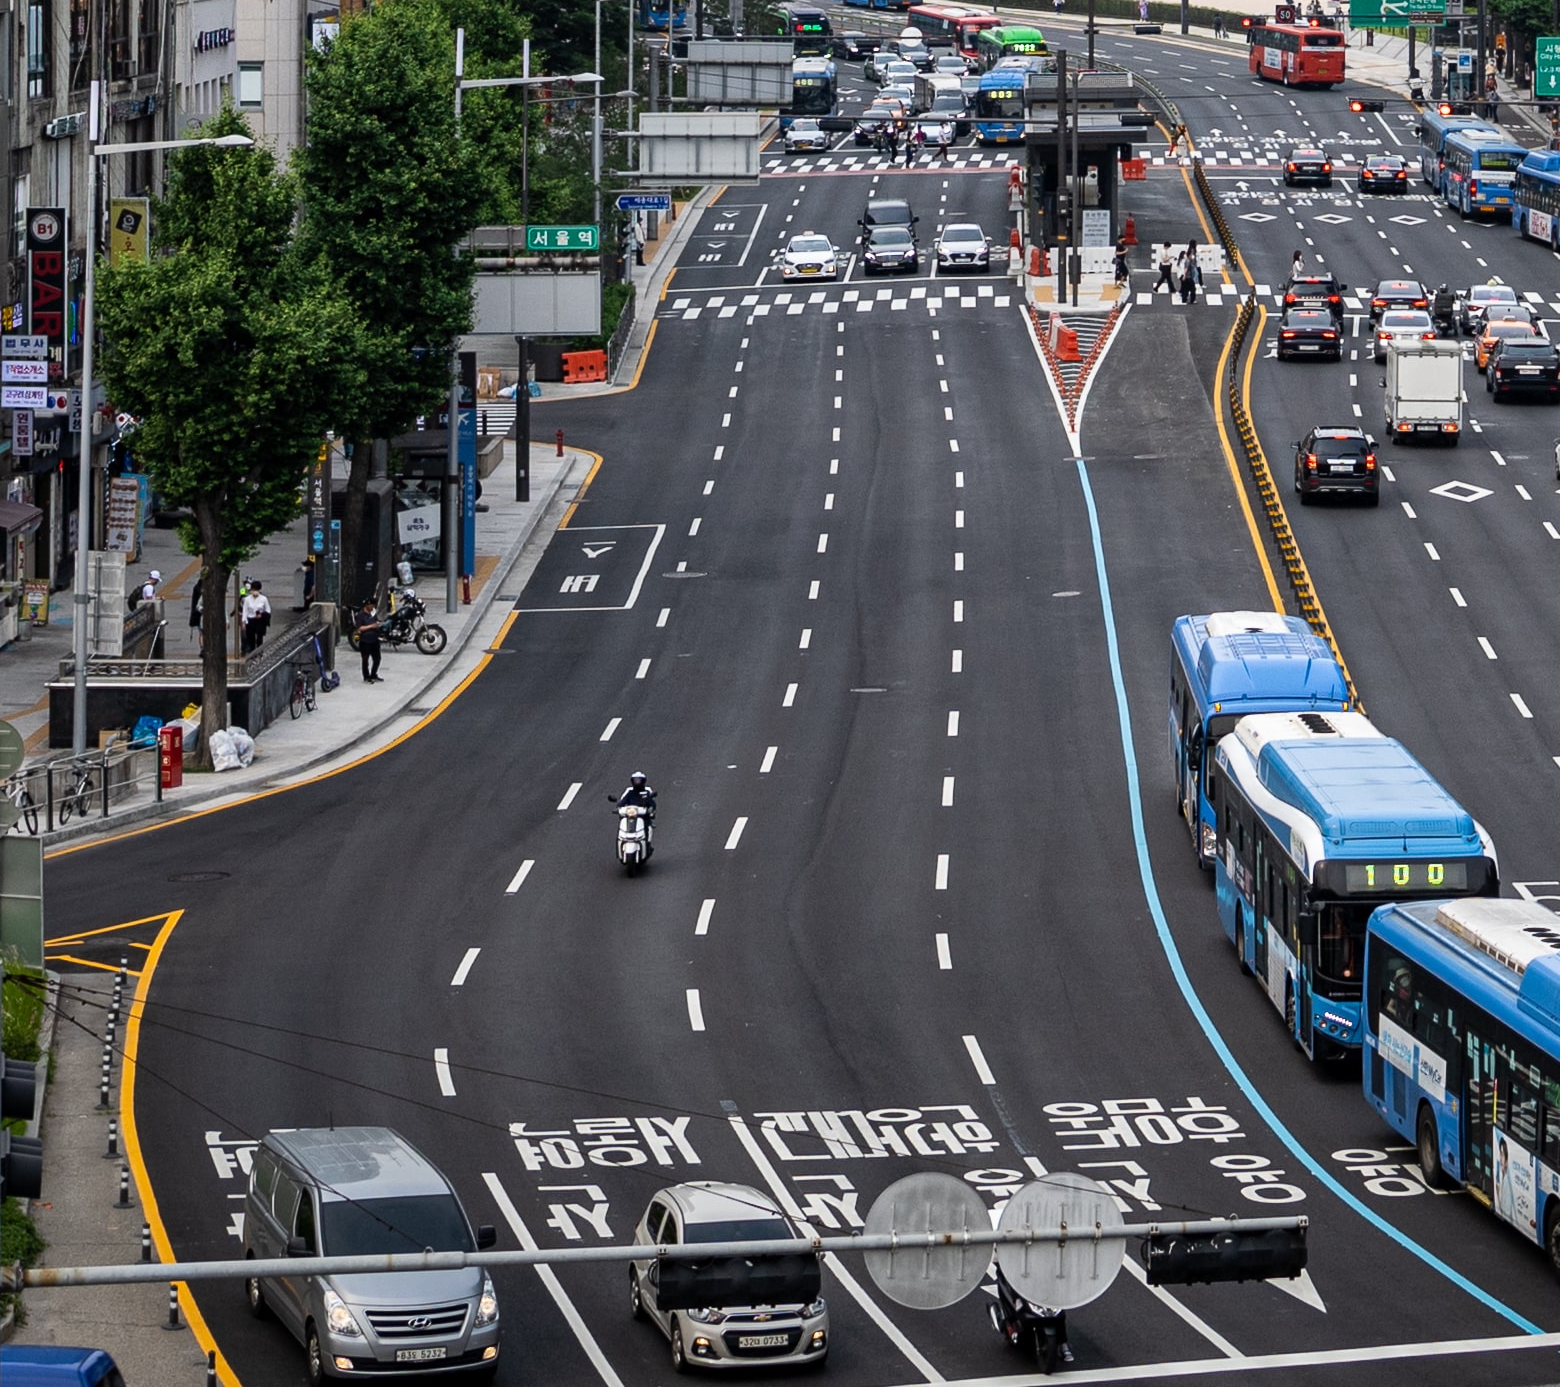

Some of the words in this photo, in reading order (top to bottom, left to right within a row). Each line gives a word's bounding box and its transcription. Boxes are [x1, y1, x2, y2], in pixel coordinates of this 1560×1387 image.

[36, 222, 54, 235] B1
[532, 230, 592, 247] 서울역
[33, 251, 62, 337] BAR
[5, 337, 44, 348] 법무사
[1365, 863, 1445, 886] 100
[762, 1337, 785, 1346] 0733
